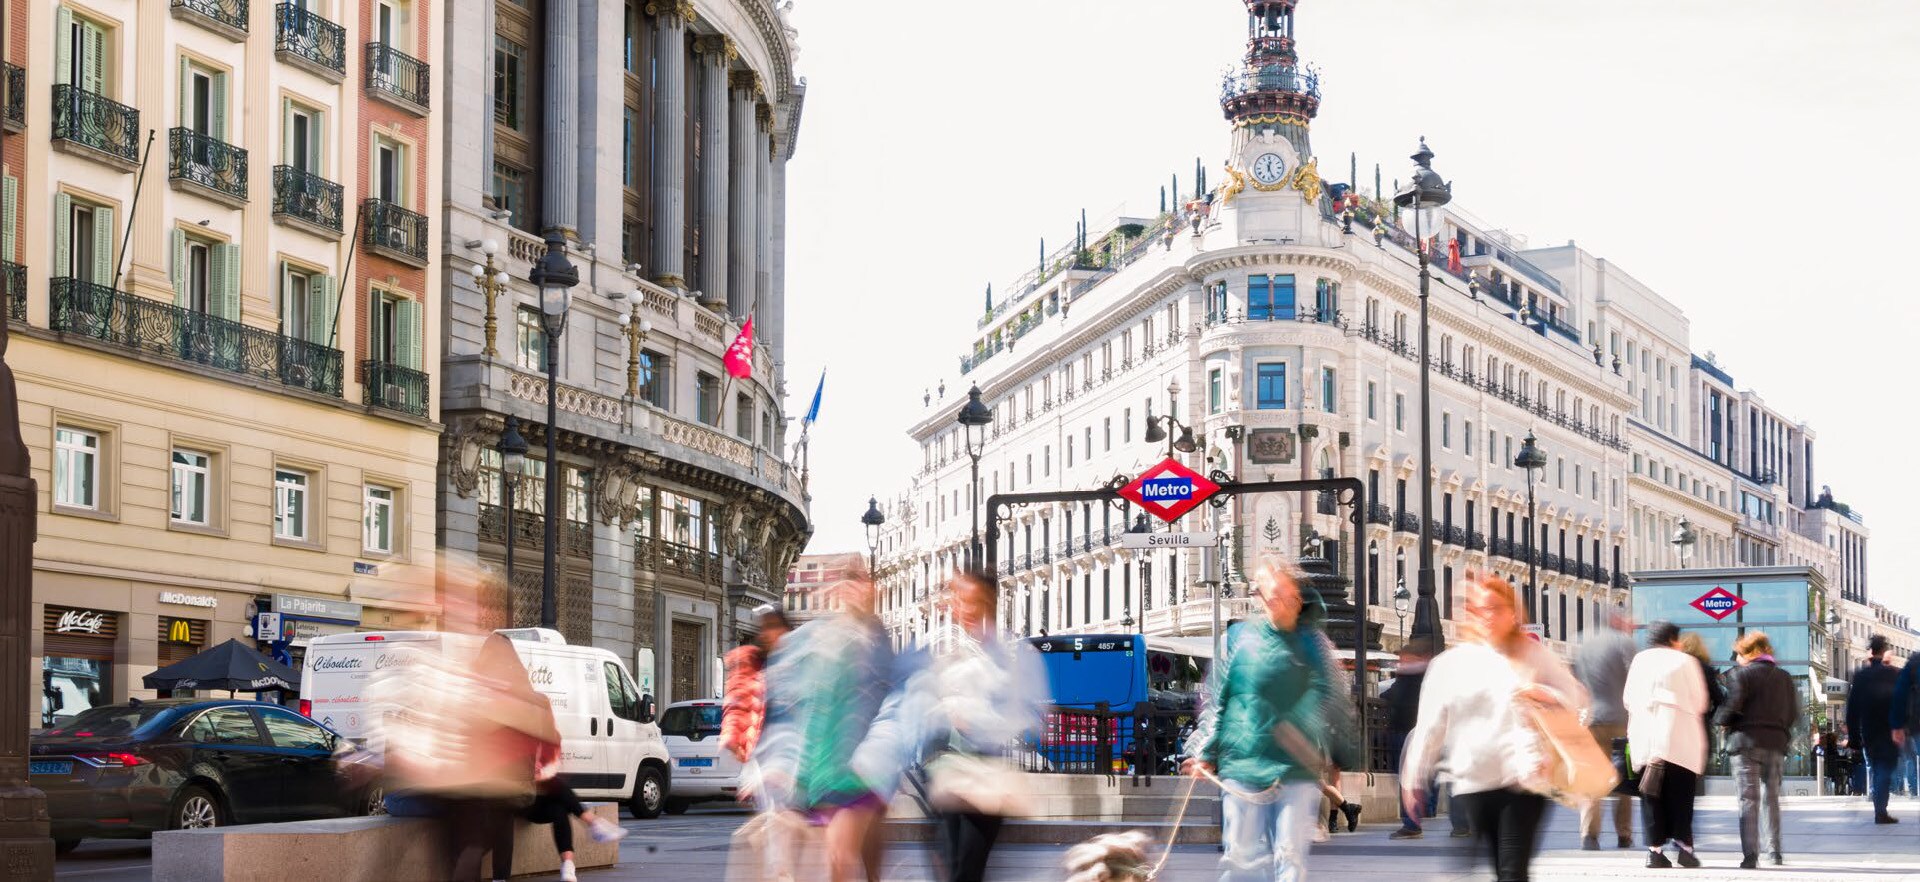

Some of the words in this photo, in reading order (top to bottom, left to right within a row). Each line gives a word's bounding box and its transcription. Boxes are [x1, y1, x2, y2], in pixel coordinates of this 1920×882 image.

[1145, 483, 1189, 497] Metro
[1148, 535, 1190, 545] Sevilla
[161, 592, 217, 608] McDonald's
[281, 598, 292, 610] La
[294, 600, 326, 613] Pajarita
[1705, 599, 1732, 608] Metro
[1075, 638, 1083, 650] 5
[1097, 642, 1115, 650] 4857
[313, 655, 362, 671] Ciboulette
[351, 716, 356, 726] 3
